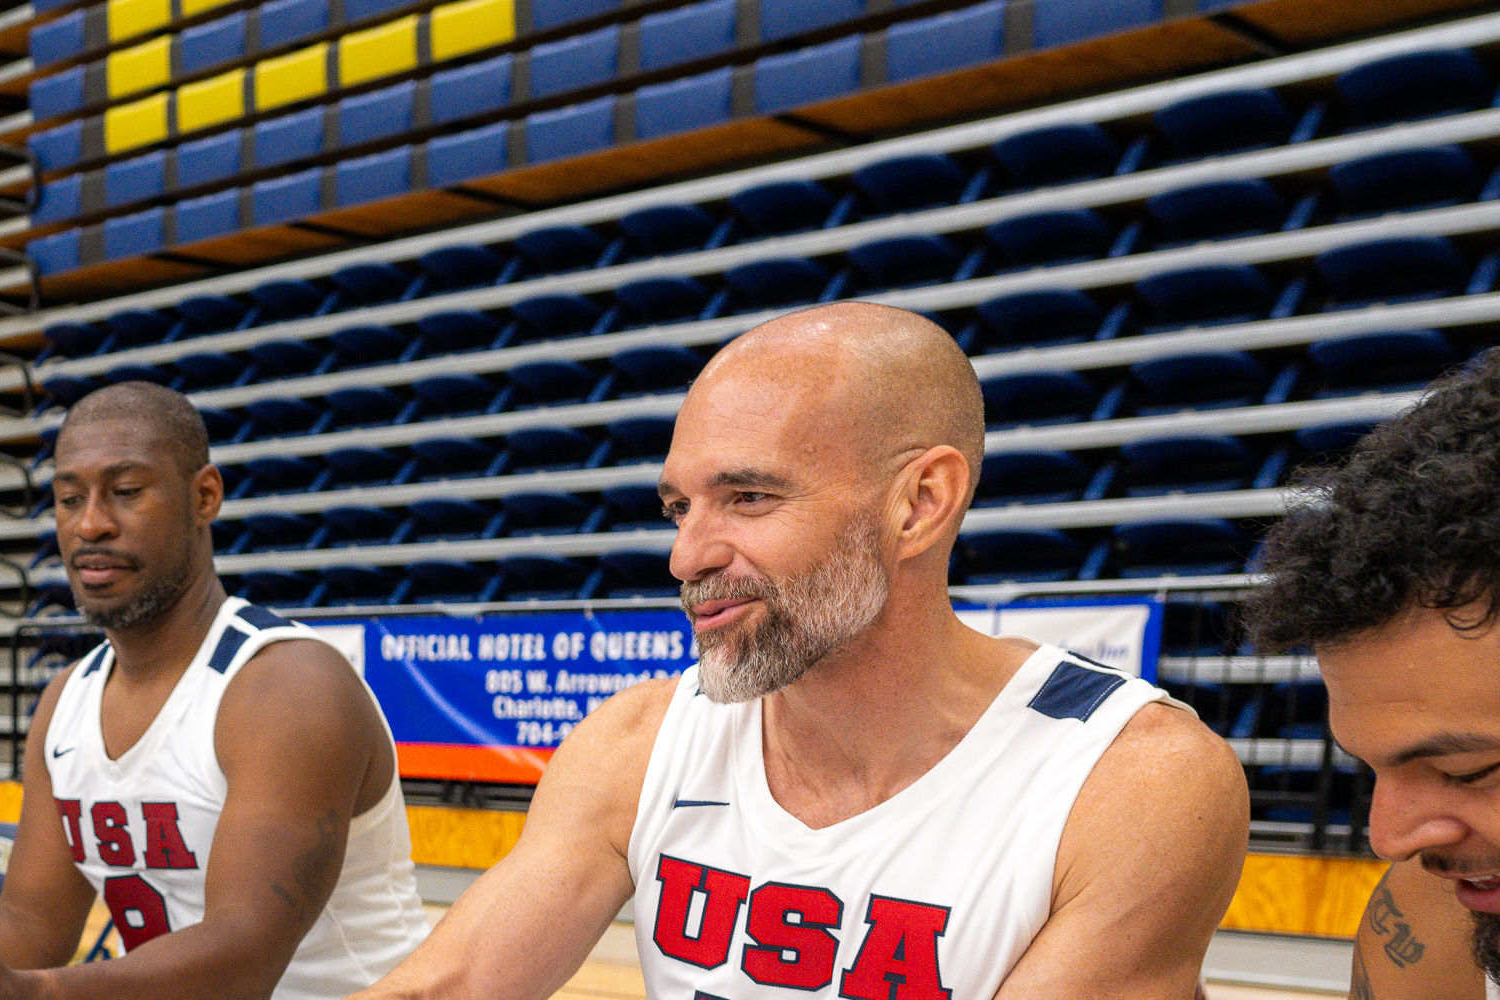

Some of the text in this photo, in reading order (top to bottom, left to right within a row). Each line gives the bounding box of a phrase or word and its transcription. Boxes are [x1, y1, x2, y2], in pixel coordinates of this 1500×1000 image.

[381, 634, 472, 661] OFFICIAL
[478, 633, 546, 661] HOTEL
[553, 632, 585, 660] OF
[590, 630, 683, 662] QUEENS
[486, 669, 523, 694] 805
[526, 669, 552, 694] W.
[492, 695, 584, 720] Charlotte,
[54, 798, 199, 870] USA
